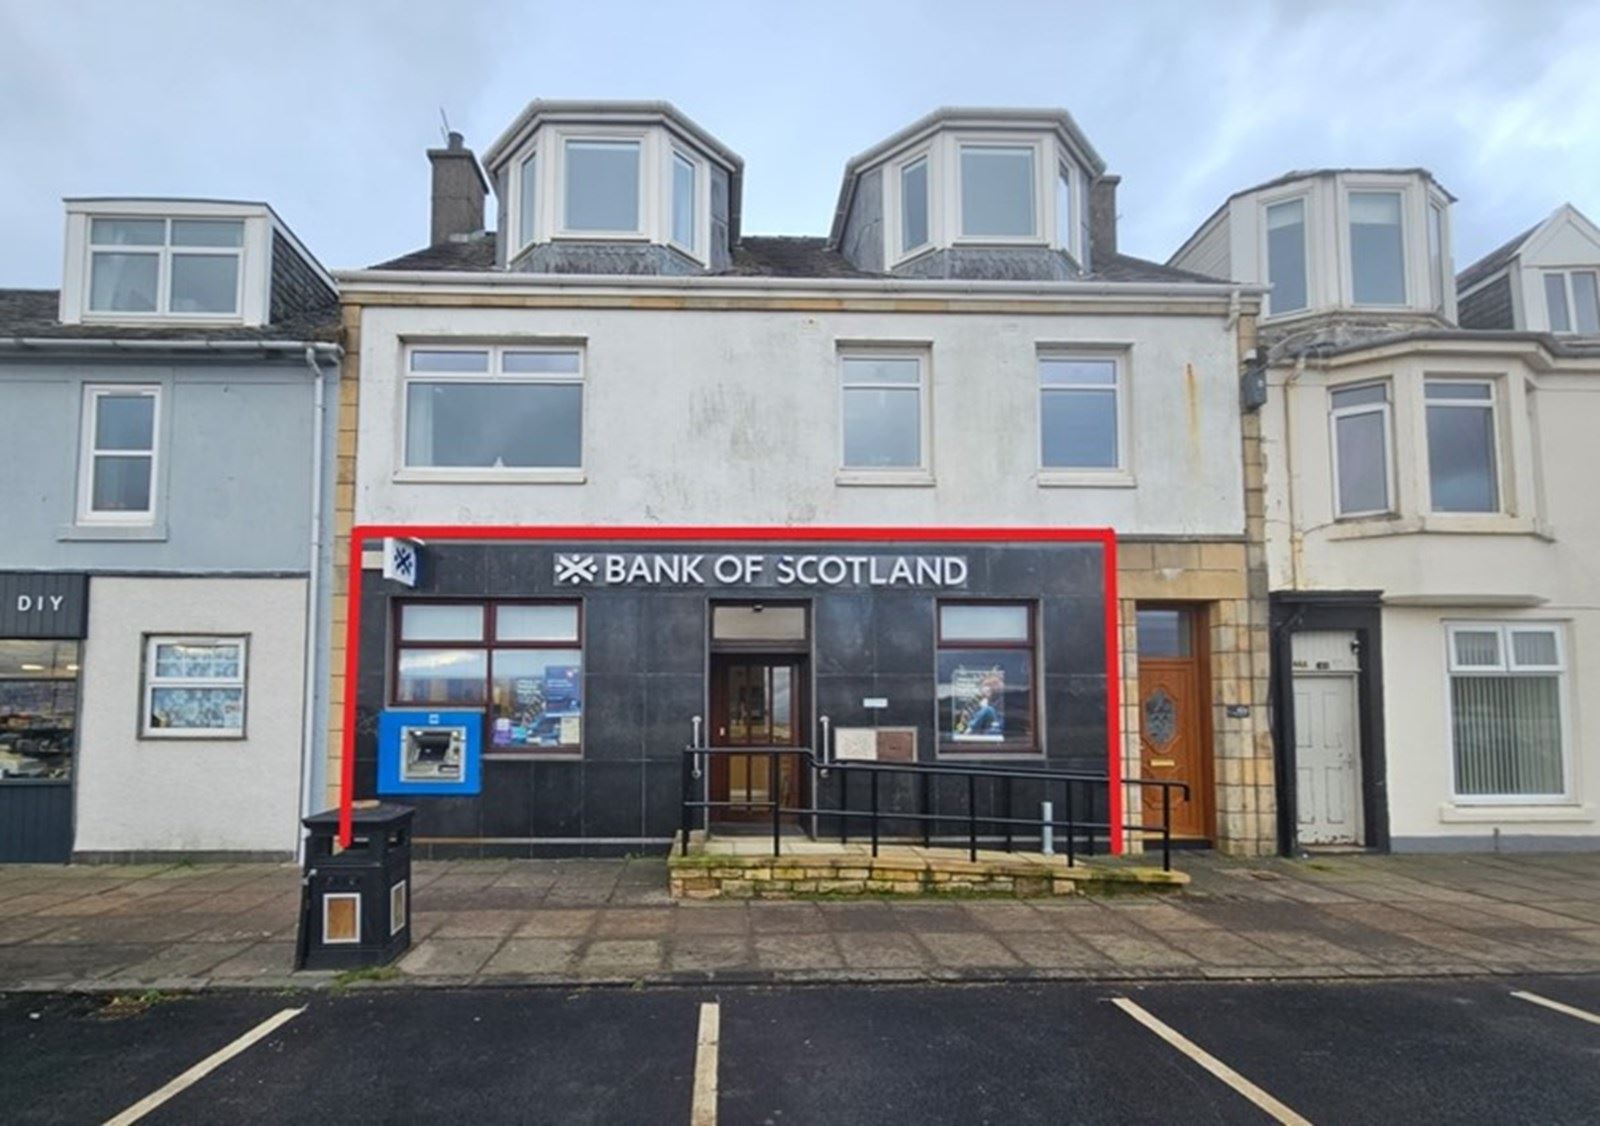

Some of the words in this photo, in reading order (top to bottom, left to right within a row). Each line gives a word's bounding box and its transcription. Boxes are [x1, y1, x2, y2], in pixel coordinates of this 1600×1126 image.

[604, 555, 705, 584] BANK
[713, 554, 763, 585] OF
[777, 555, 968, 586] SCOTLAND
[17, 594, 64, 611] DIY
